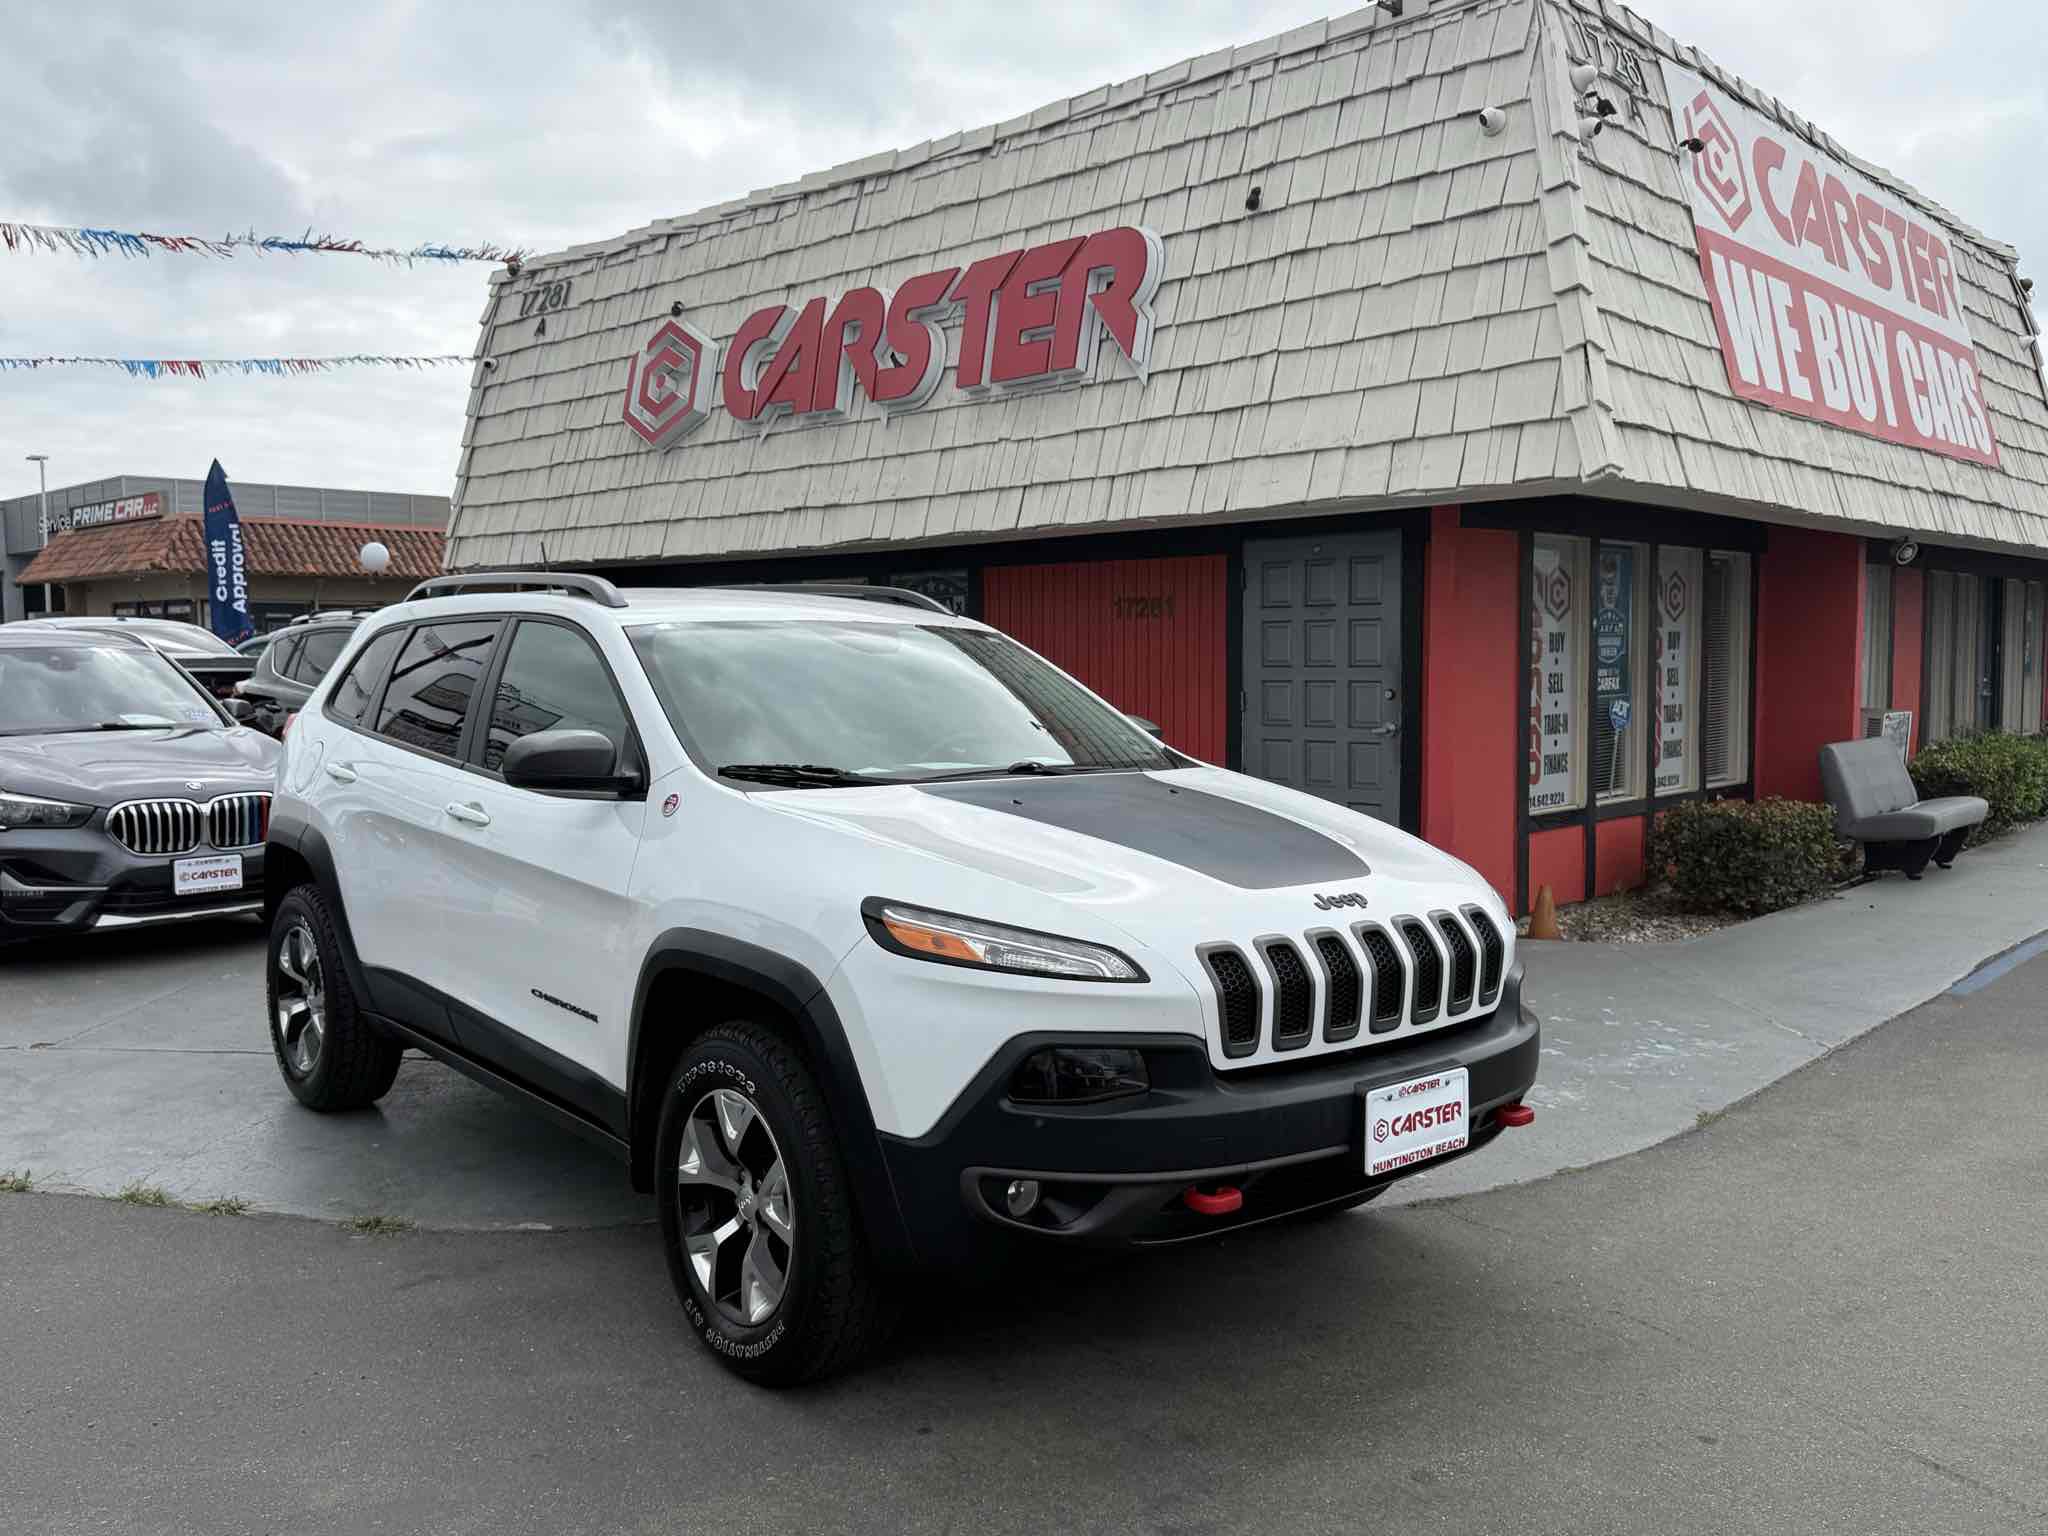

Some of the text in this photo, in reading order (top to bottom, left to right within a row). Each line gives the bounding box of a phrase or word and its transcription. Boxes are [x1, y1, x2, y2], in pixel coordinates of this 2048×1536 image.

[1752, 136, 1960, 320] CARSTER
[722, 226, 1158, 422] CARSTER
[1710, 250, 1992, 456] WE BUY CARS
[211, 539, 228, 602] Credit
[1548, 631, 1566, 653] BUY
[1547, 672, 1564, 694] SELL
[1543, 752, 1569, 776] FINANCE
[191, 867, 238, 880] CARSTER
[1313, 892, 1368, 911] Jeep
[1407, 1078, 1441, 1095] CARSTER
[1391, 1100, 1462, 1137] CARSTER
[1372, 1137, 1466, 1174] HUNTINGTON BEACH
